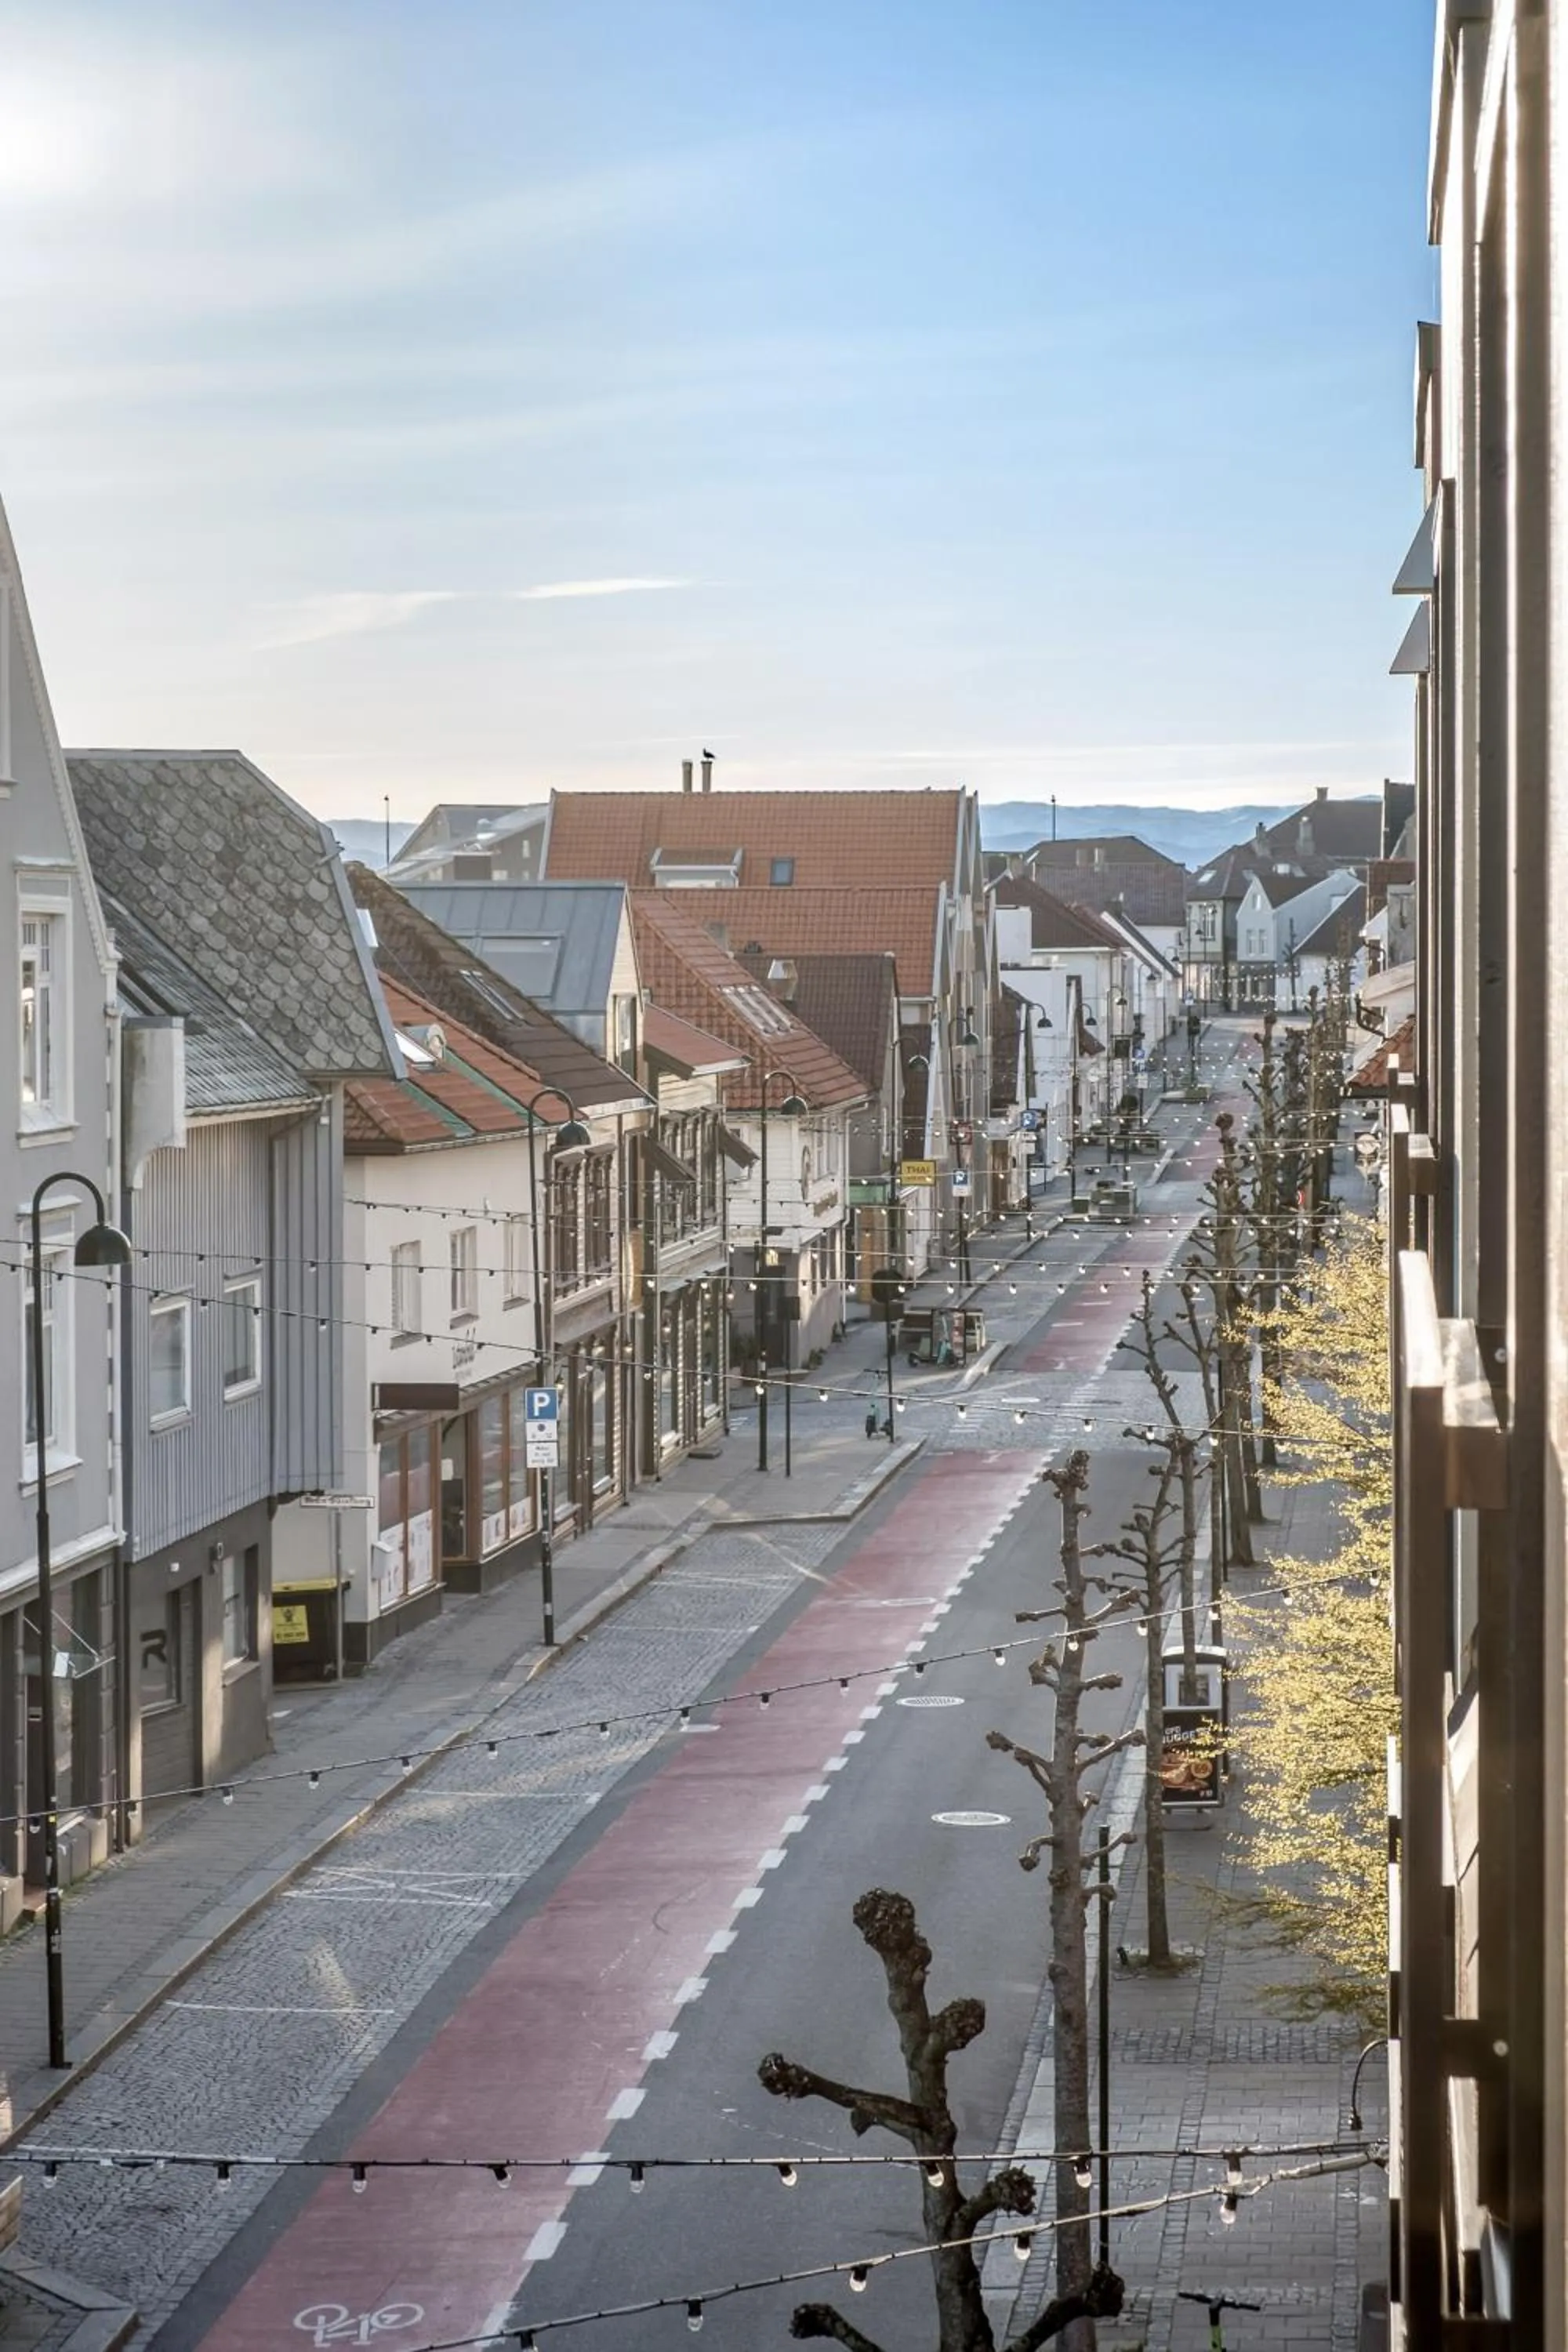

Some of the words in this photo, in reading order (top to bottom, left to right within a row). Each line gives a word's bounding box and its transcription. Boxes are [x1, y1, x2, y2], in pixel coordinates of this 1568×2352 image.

[955, 1171, 965, 1183] P
[534, 1392, 550, 1417] P
[140, 1629, 167, 1669] R
